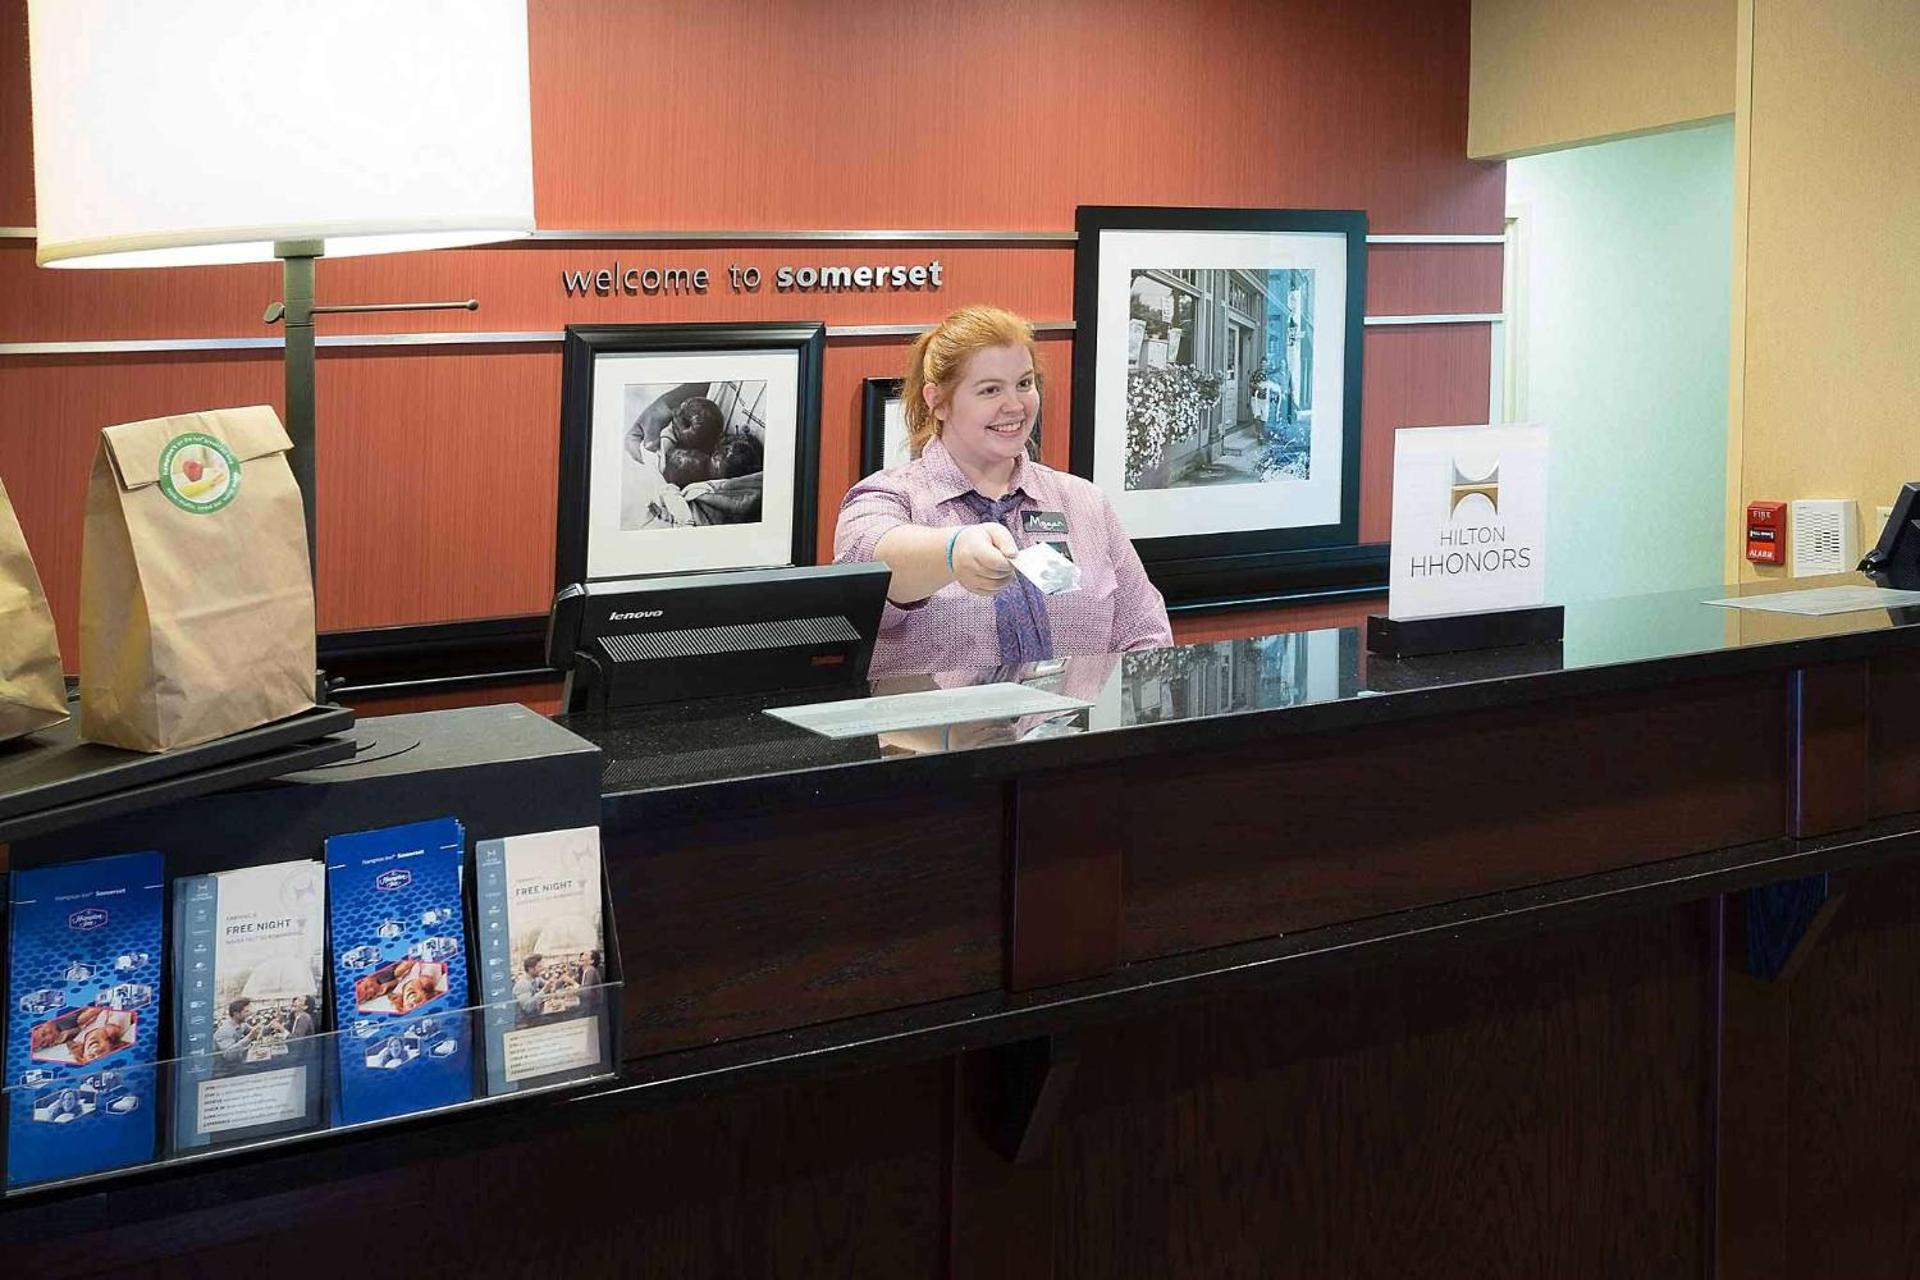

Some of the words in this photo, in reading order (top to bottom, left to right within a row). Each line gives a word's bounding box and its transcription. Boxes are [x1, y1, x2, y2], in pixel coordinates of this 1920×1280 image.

[562, 262, 709, 293] welcome
[729, 263, 762, 291] to
[775, 259, 943, 290] somerset
[1440, 525, 1506, 546] HILTON
[1410, 547, 1532, 578] HHONORS
[608, 608, 664, 622] lenovo
[515, 885, 541, 897] FREE
[542, 880, 573, 892] NIGHT
[225, 922, 254, 936] FREE
[256, 918, 293, 932] NIGHT
